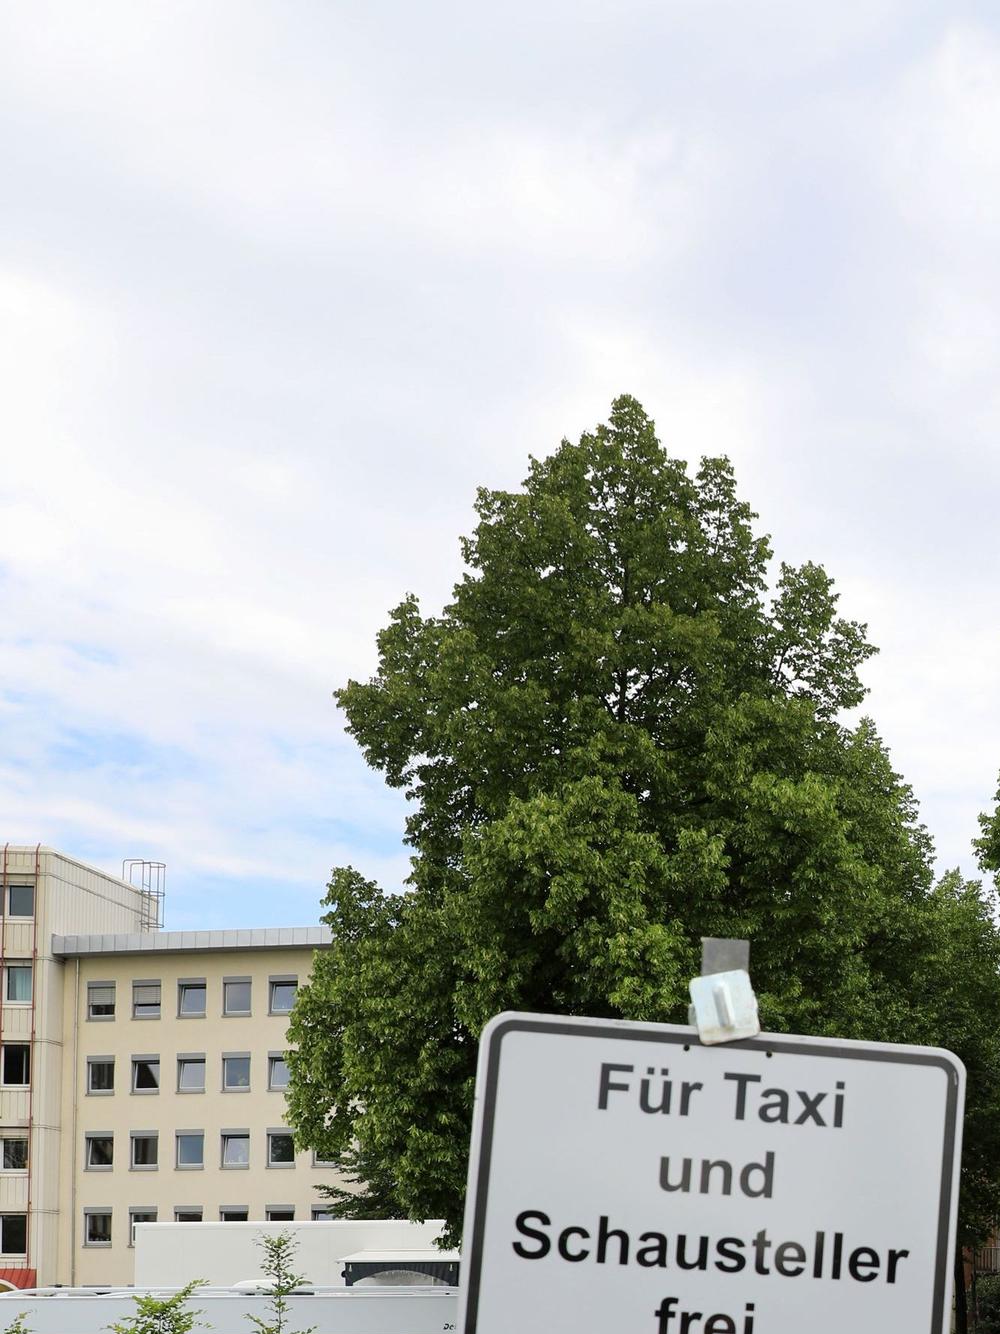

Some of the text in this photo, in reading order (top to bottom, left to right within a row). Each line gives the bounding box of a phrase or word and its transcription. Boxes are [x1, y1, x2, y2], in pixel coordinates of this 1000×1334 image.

[598, 1063, 845, 1128] Für Taxi
[660, 1152, 774, 1198] und
[512, 1210, 909, 1284] Schausteller
